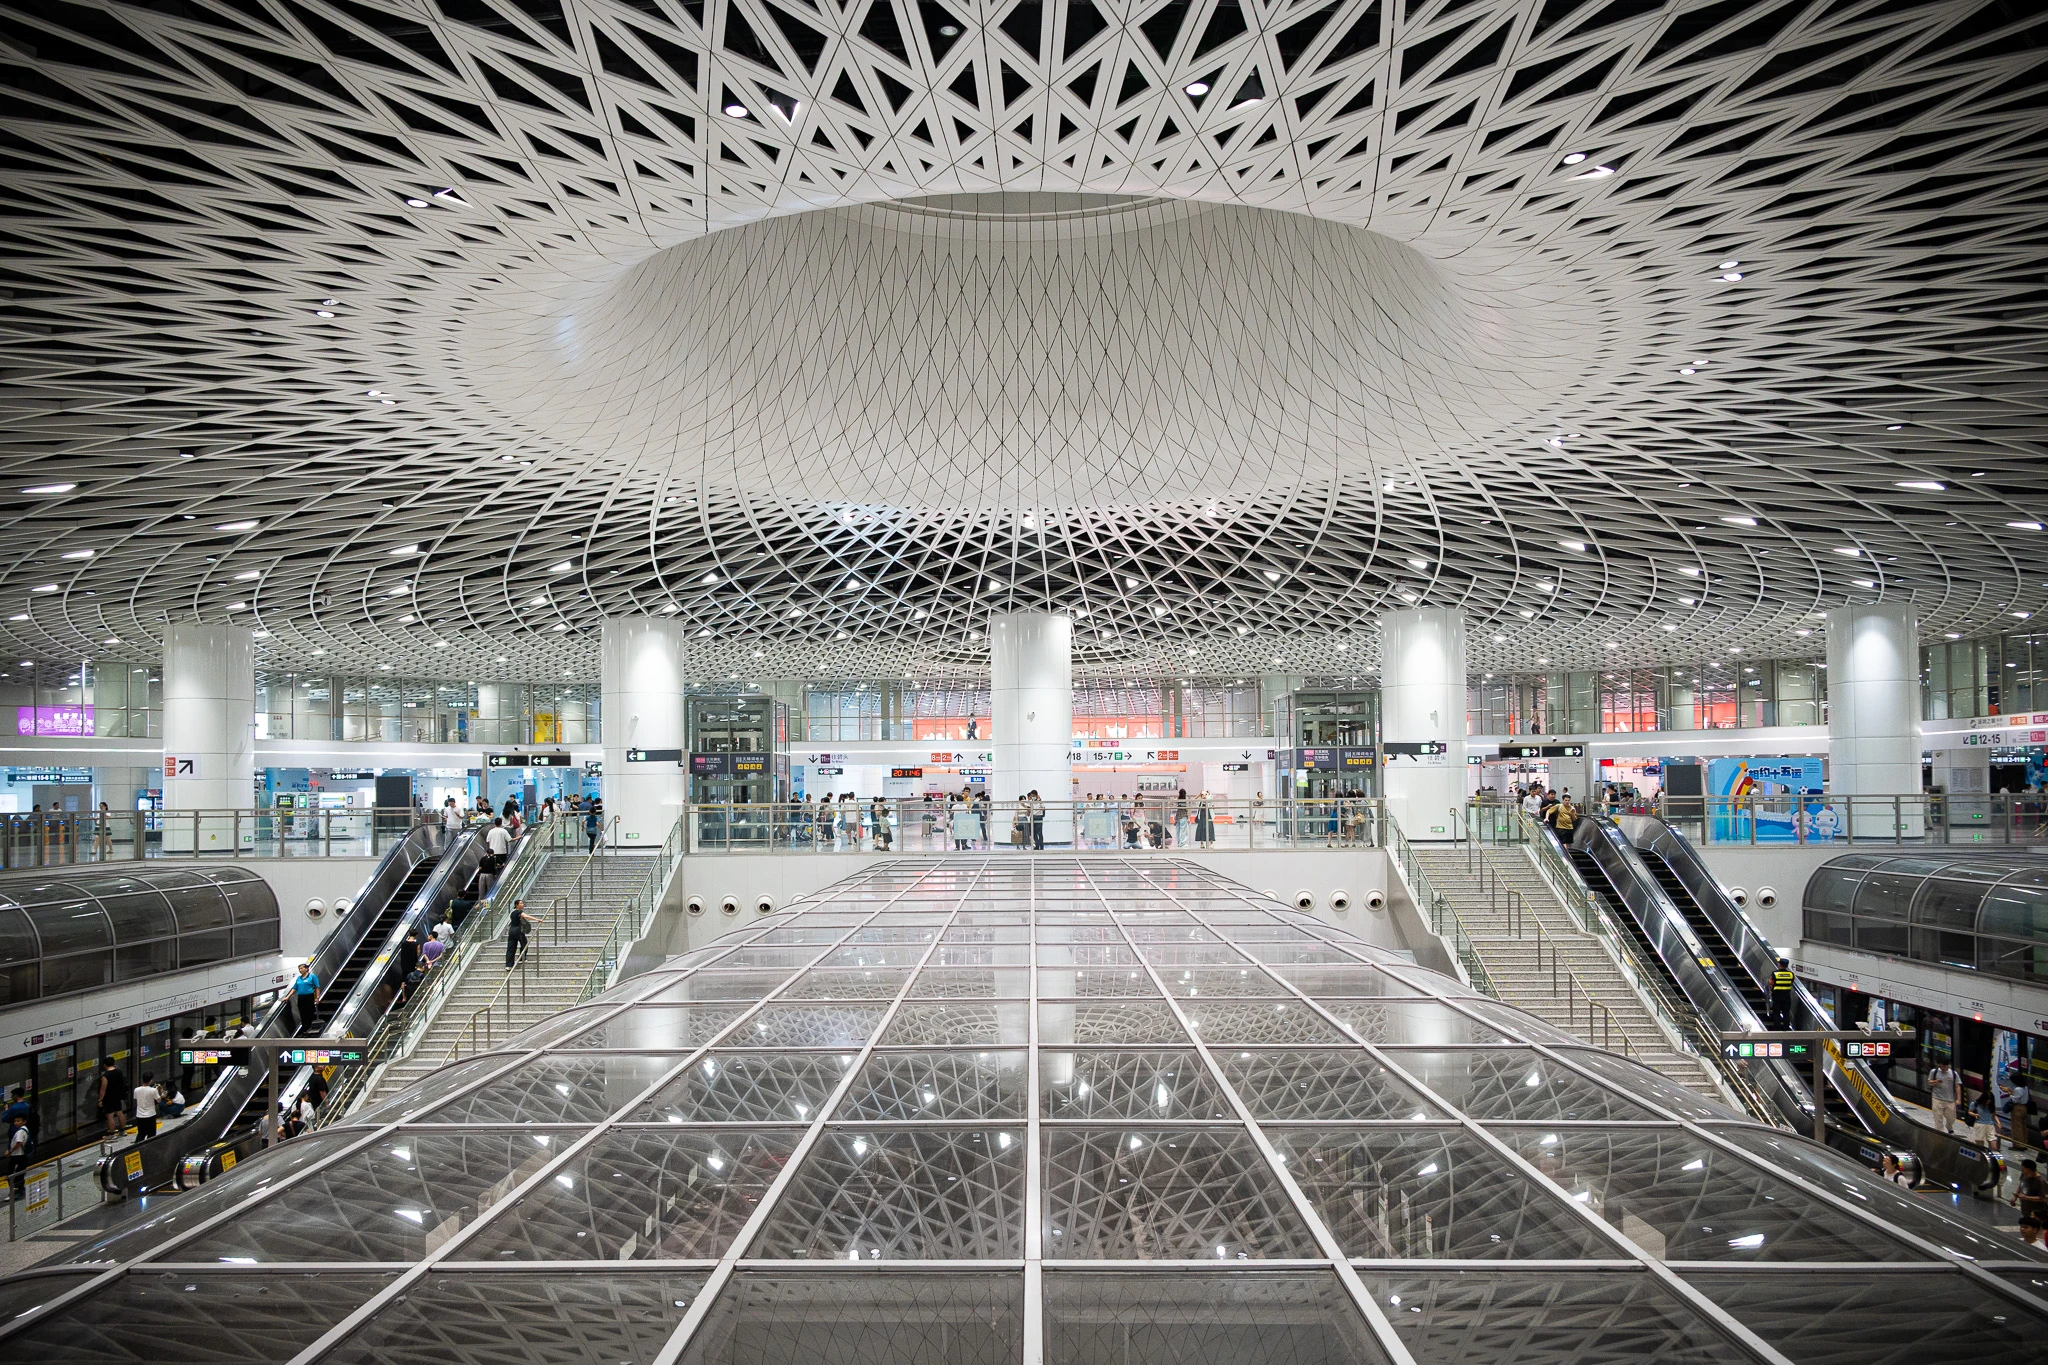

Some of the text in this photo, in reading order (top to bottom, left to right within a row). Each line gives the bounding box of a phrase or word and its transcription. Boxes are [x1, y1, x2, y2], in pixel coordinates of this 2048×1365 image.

[1979, 734, 2001, 745] 12-15
[1093, 752, 1113, 761] 15-7
[1748, 766, 1802, 780] 相约十五运
